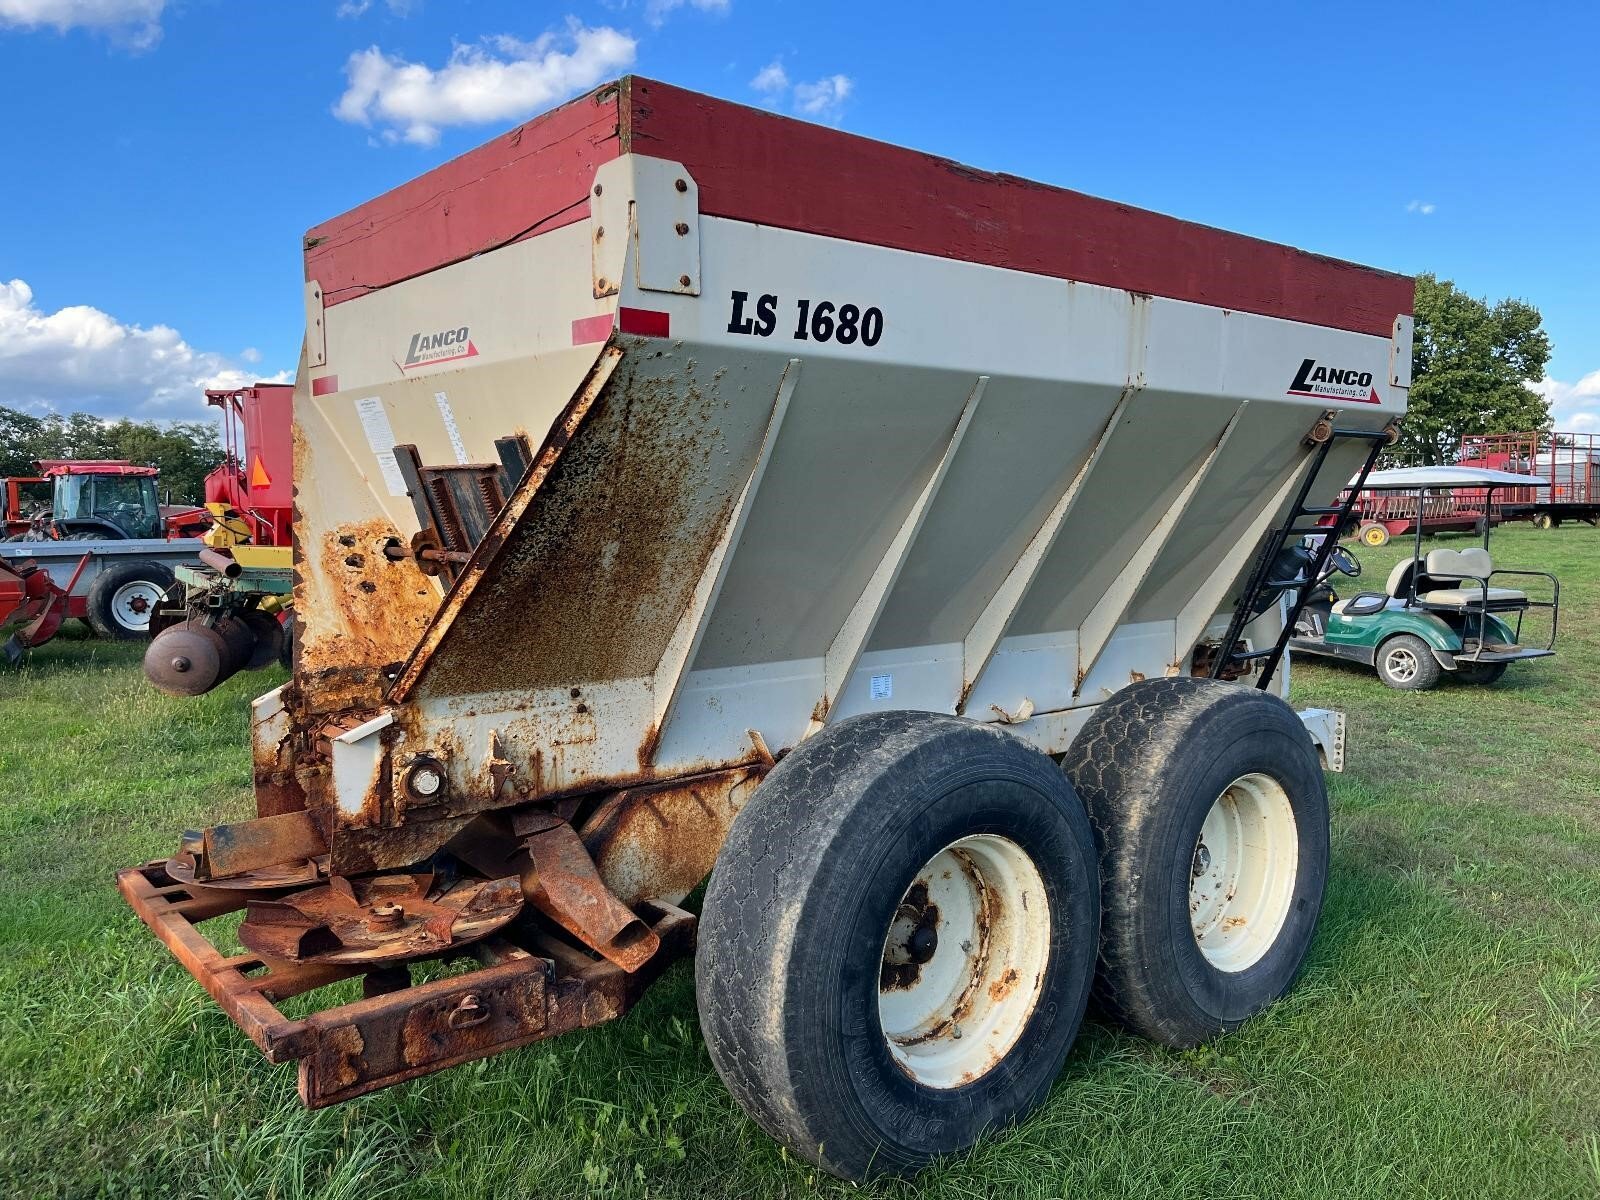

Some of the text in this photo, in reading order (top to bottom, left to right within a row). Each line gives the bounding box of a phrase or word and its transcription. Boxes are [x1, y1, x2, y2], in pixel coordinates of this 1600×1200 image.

[727, 290, 884, 347] LS 1680
[405, 326, 469, 365] LANCO
[1289, 358, 1373, 392] LANCO
